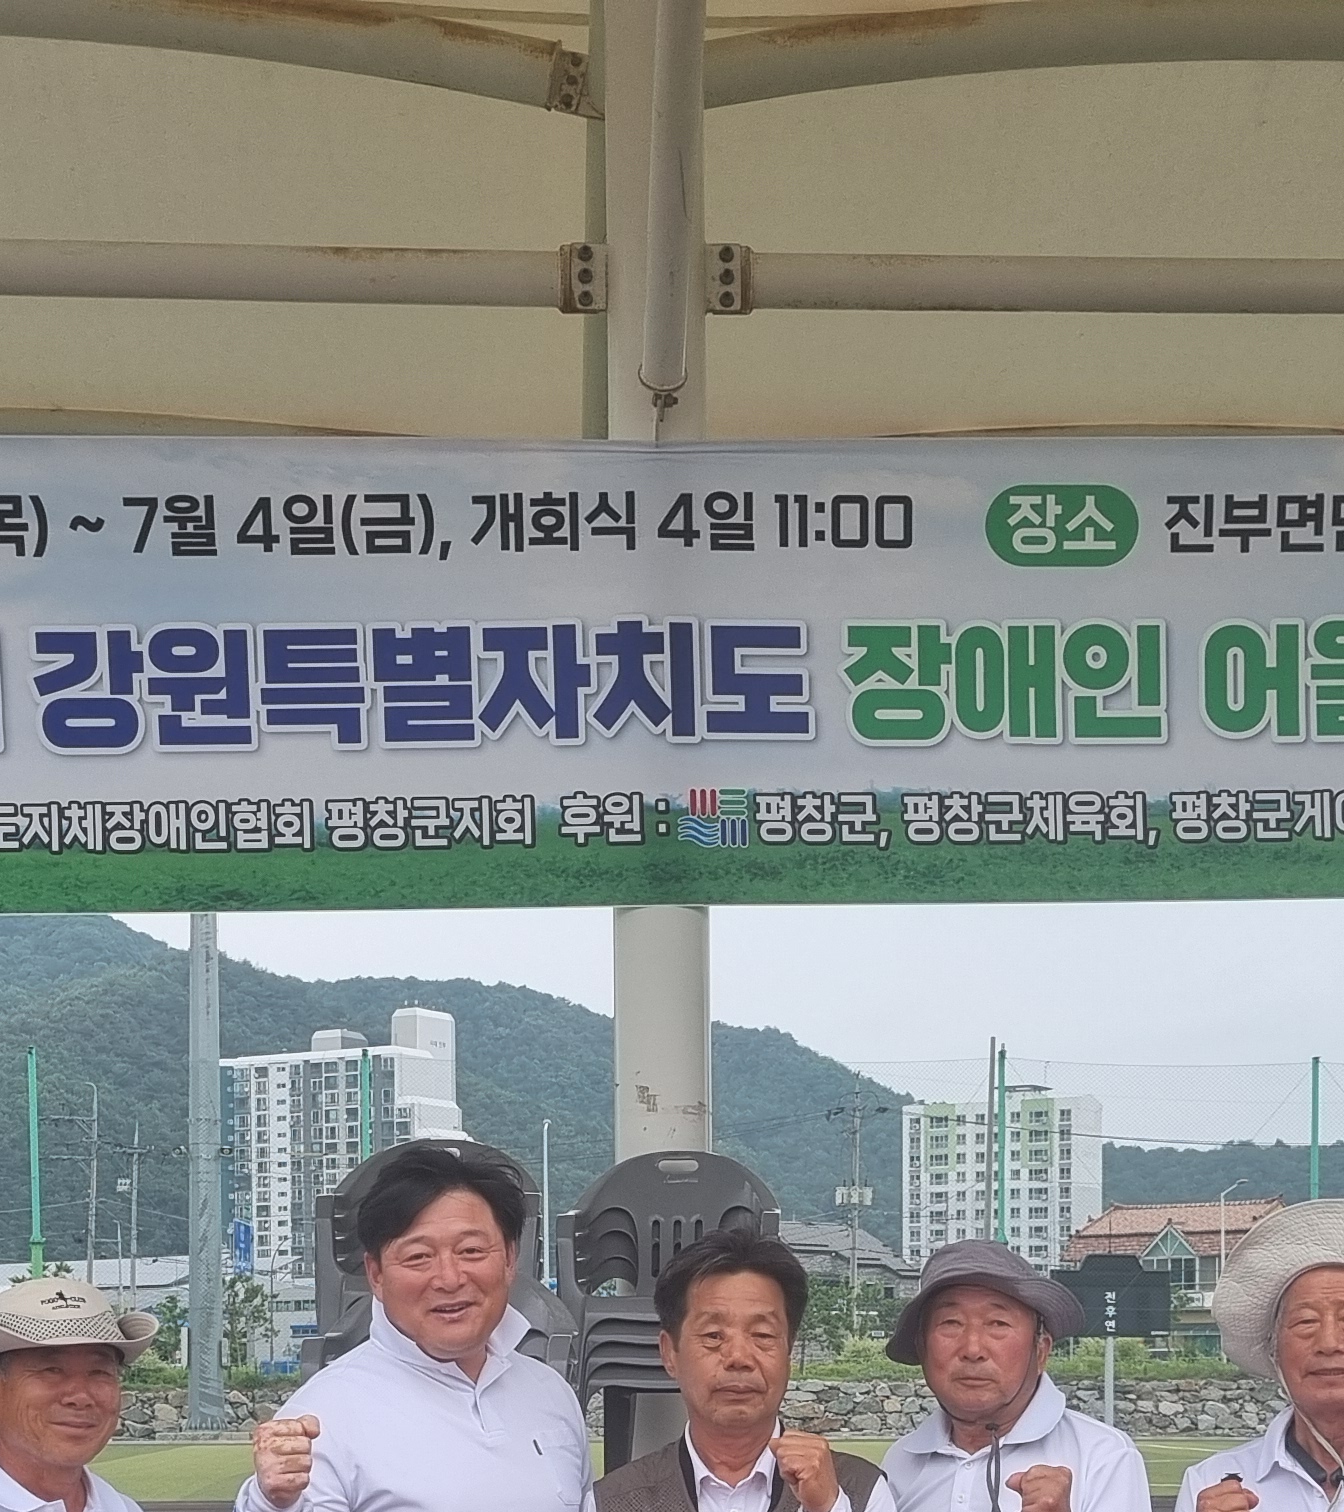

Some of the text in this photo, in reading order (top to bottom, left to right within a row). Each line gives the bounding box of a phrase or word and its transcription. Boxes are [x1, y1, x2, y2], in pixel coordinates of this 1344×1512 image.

[69, 513, 106, 532] ~
[123, 495, 218, 556] 7월
[236, 493, 452, 561] 4일(금),
[470, 490, 637, 552] 개회식
[657, 491, 755, 550] 4일
[774, 493, 914, 549] 11:00
[1007, 494, 1117, 554] 장소
[28, 616, 816, 754] 강원특별자치도
[840, 617, 1167, 746] 장애인
[326, 796, 533, 849] 평창군지회
[560, 792, 643, 844] 후원
[755, 792, 892, 849] 평창군,
[904, 790, 1159, 847] 평창군체육회,
